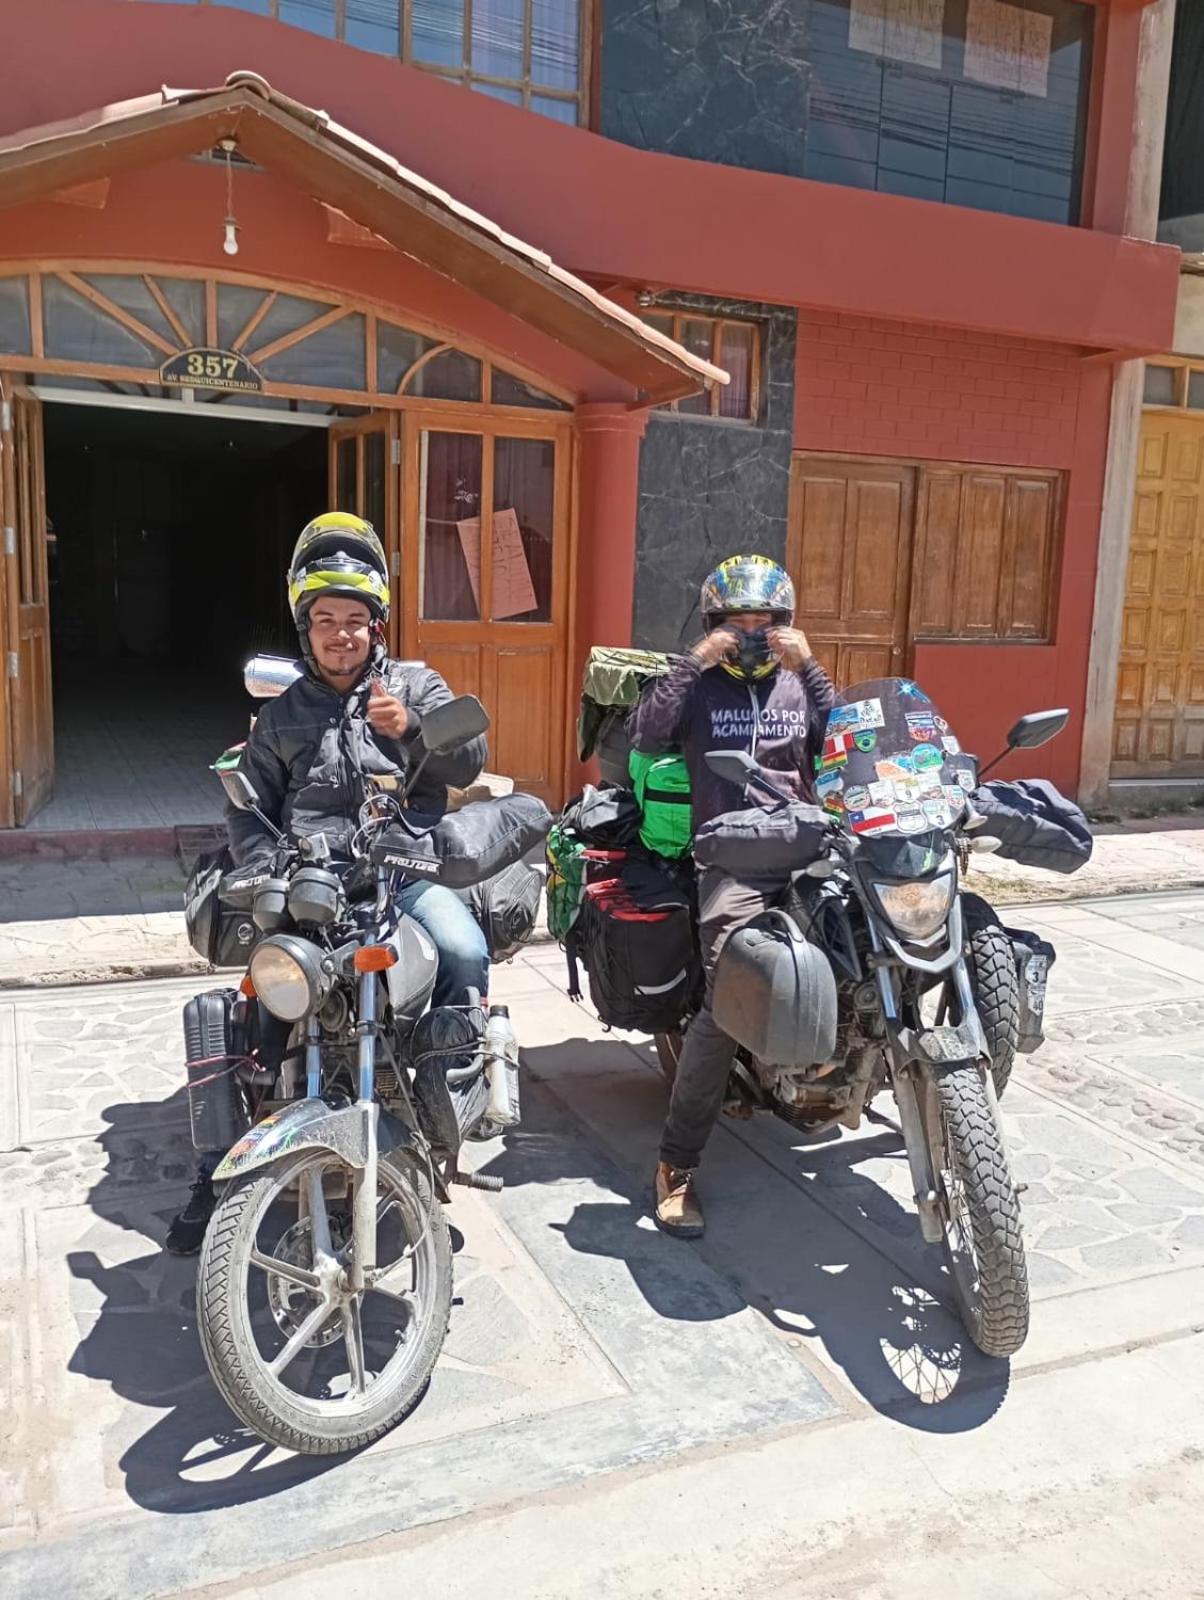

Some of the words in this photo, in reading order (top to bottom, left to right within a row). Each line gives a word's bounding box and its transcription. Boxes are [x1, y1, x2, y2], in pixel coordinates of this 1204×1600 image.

[187, 354, 238, 378] 357
[782, 710, 806, 724] POR
[935, 814, 945, 826] 3
[1032, 971, 1039, 983] 3
